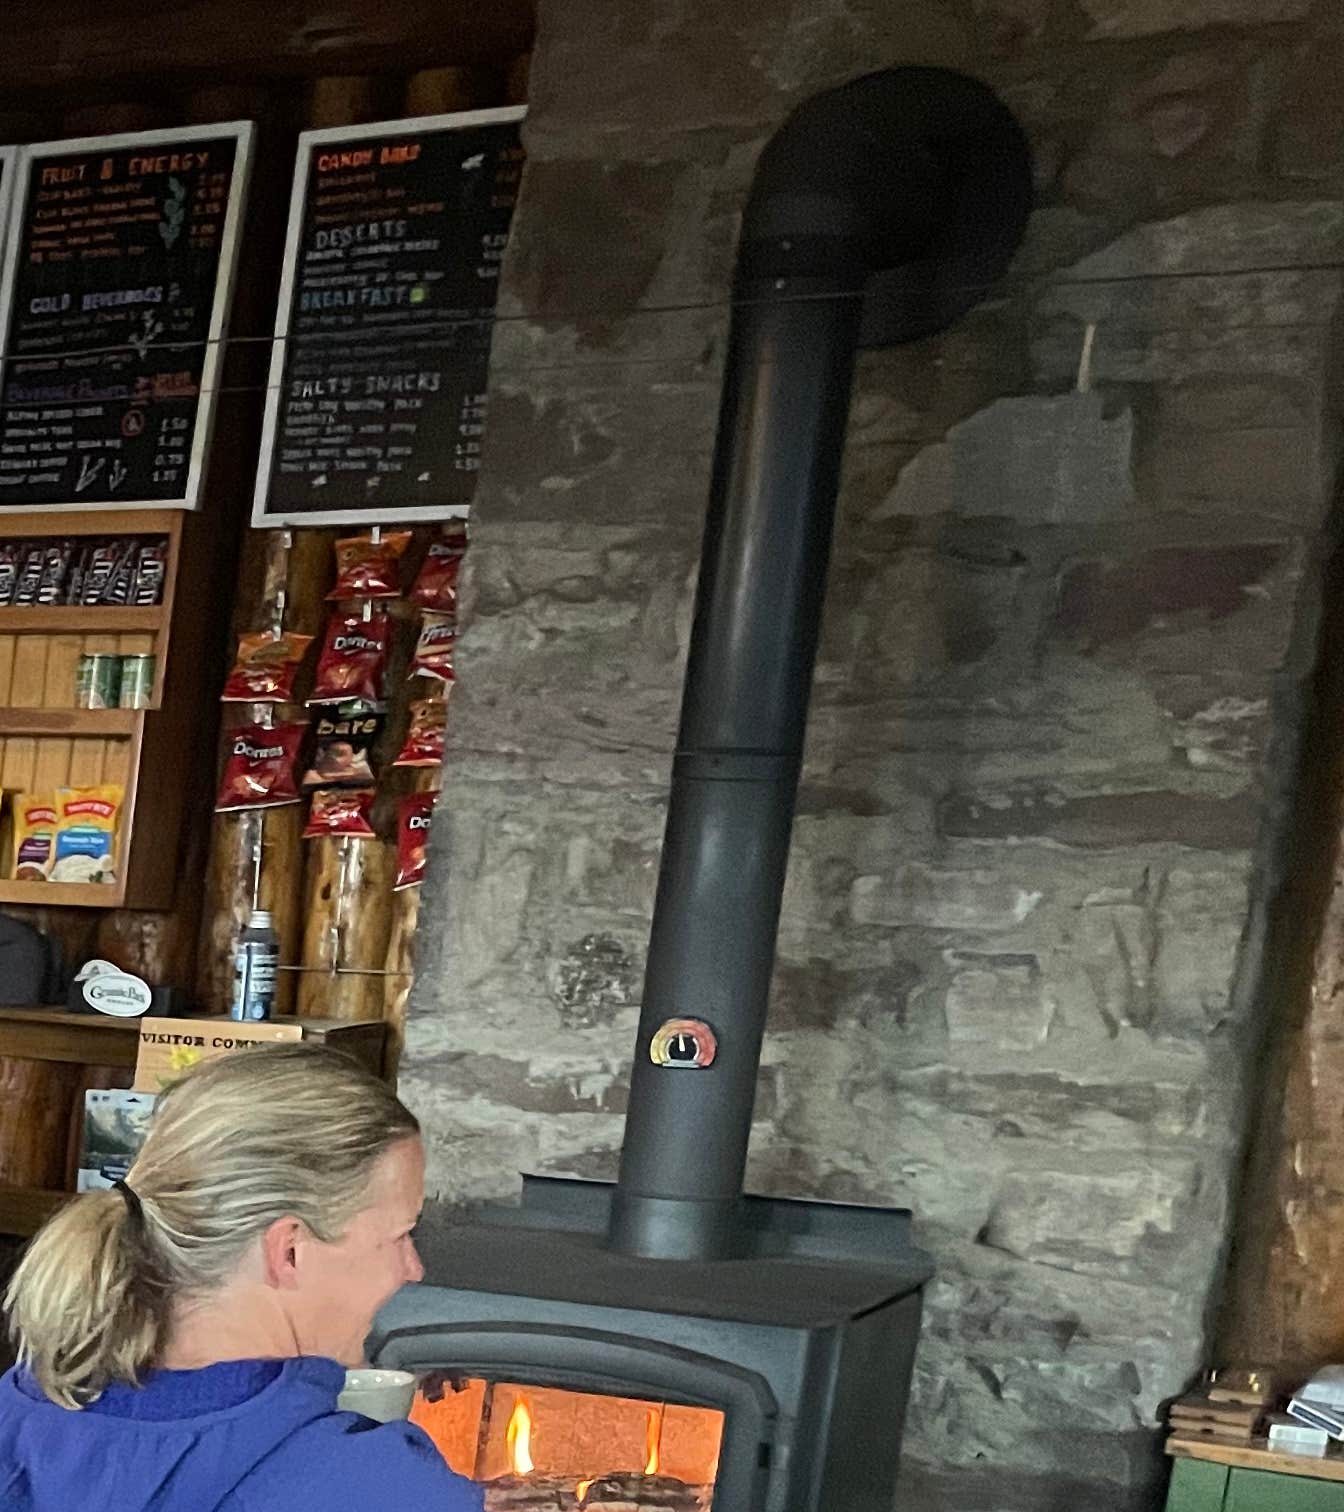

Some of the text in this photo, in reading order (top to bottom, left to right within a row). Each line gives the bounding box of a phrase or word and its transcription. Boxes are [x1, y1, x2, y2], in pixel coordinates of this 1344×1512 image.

[128, 151, 209, 176] ENERGY
[30, 286, 163, 315] COLD BEVERAGES
[291, 372, 441, 399] SALTY SNACKS
[333, 635, 384, 652] Doritos
[316, 718, 378, 736] bare
[233, 740, 285, 760] Doritos
[140, 1032, 206, 1048] VISITOR
